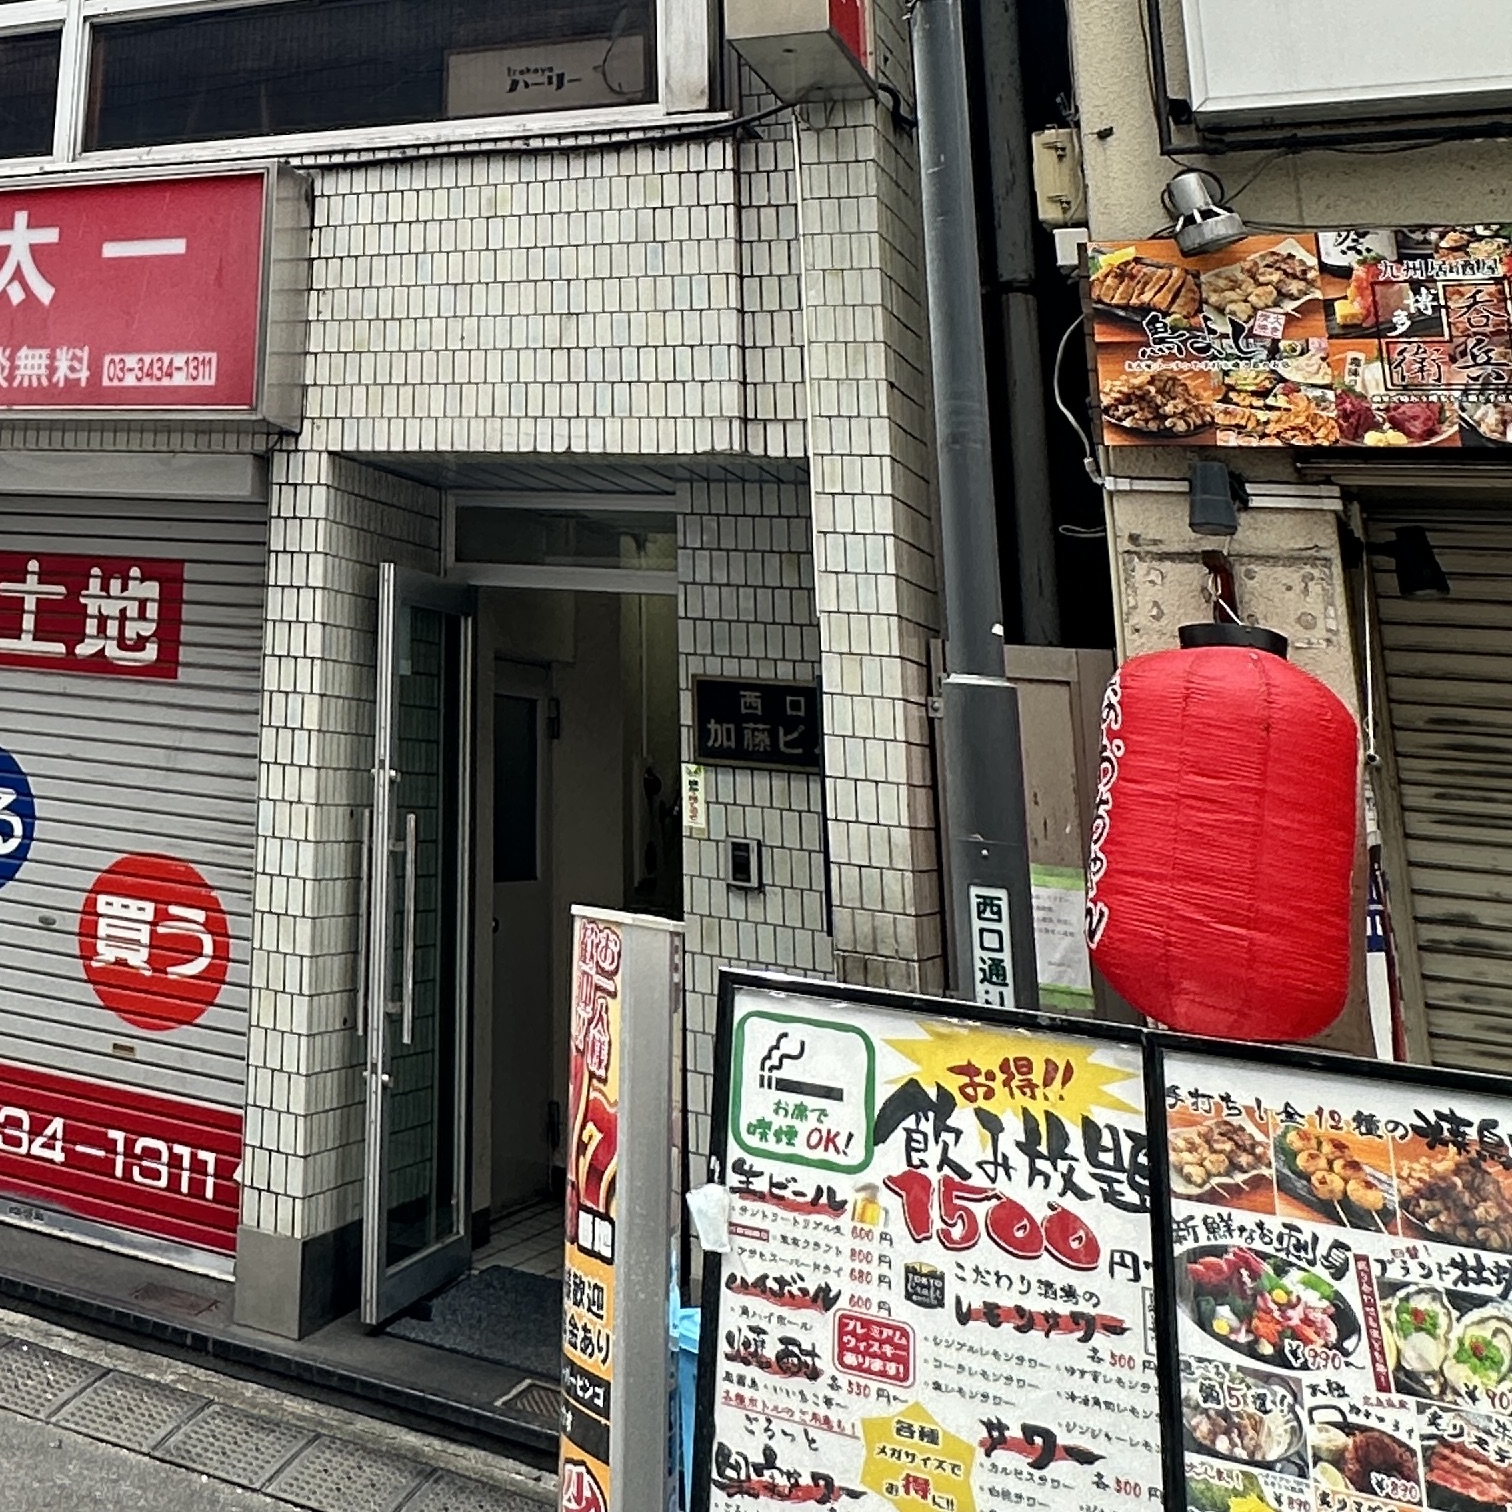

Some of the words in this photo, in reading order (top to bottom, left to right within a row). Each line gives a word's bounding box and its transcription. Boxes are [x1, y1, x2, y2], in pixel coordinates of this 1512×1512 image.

[106, 355, 213, 384] 03-3434-1311
[739, 689, 806, 717] 西口
[706, 718, 821, 755] 加藤ビ
[90, 893, 215, 979] 買う
[806, 1126, 855, 1157] OK!
[873, 1077, 1151, 1214] 飲み放題
[729, 1157, 849, 1211] 生ビール
[842, 1318, 908, 1346] プレミアム
[955, 1293, 1133, 1343] レモンサワー
[842, 1334, 908, 1359] ウィスキー
[842, 1349, 905, 1379] あります!
[876, 1444, 963, 1478] メガサイズで
